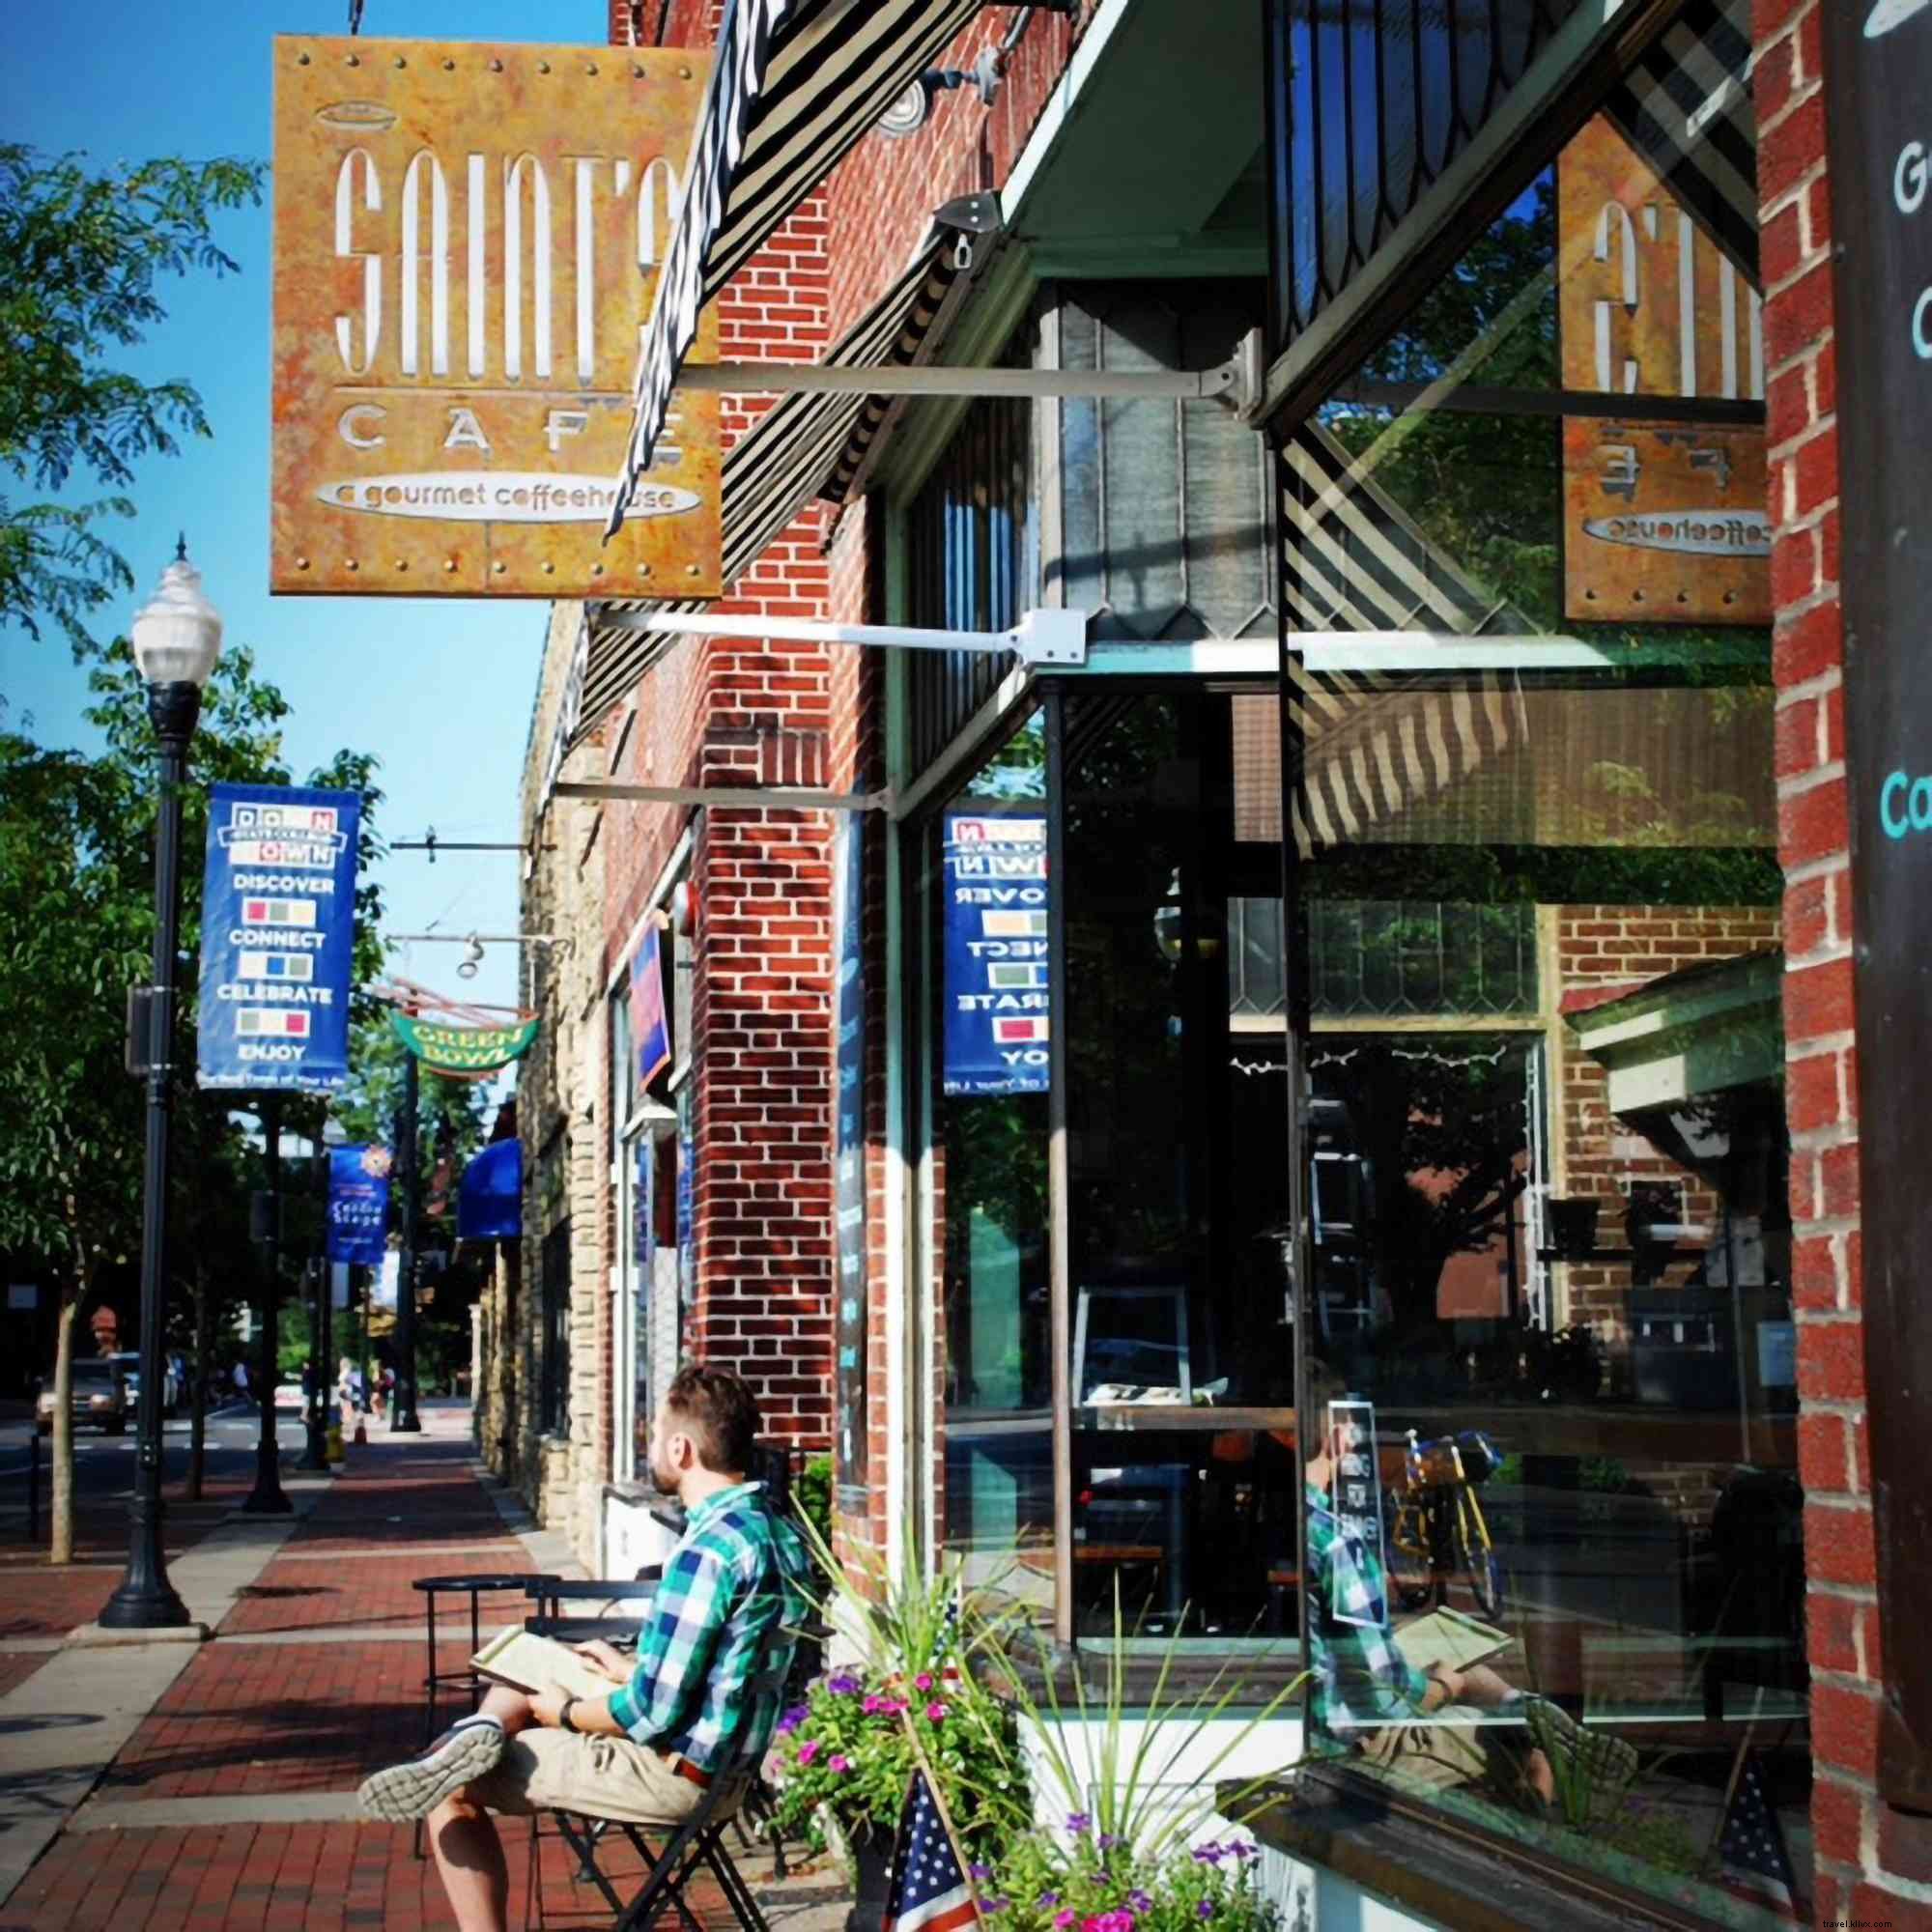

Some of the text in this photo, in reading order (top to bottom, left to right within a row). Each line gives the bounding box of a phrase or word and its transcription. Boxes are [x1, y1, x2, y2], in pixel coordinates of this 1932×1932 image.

[335, 484, 356, 503] a
[364, 483, 487, 509] gourmet
[233, 873, 335, 895] DISCOVER
[229, 928, 327, 949] CONNECT
[216, 983, 333, 1005] CELEBRATE
[412, 1025, 524, 1048] GREEN
[238, 1043, 307, 1061] ENJOY
[423, 1043, 513, 1065] BOWL
